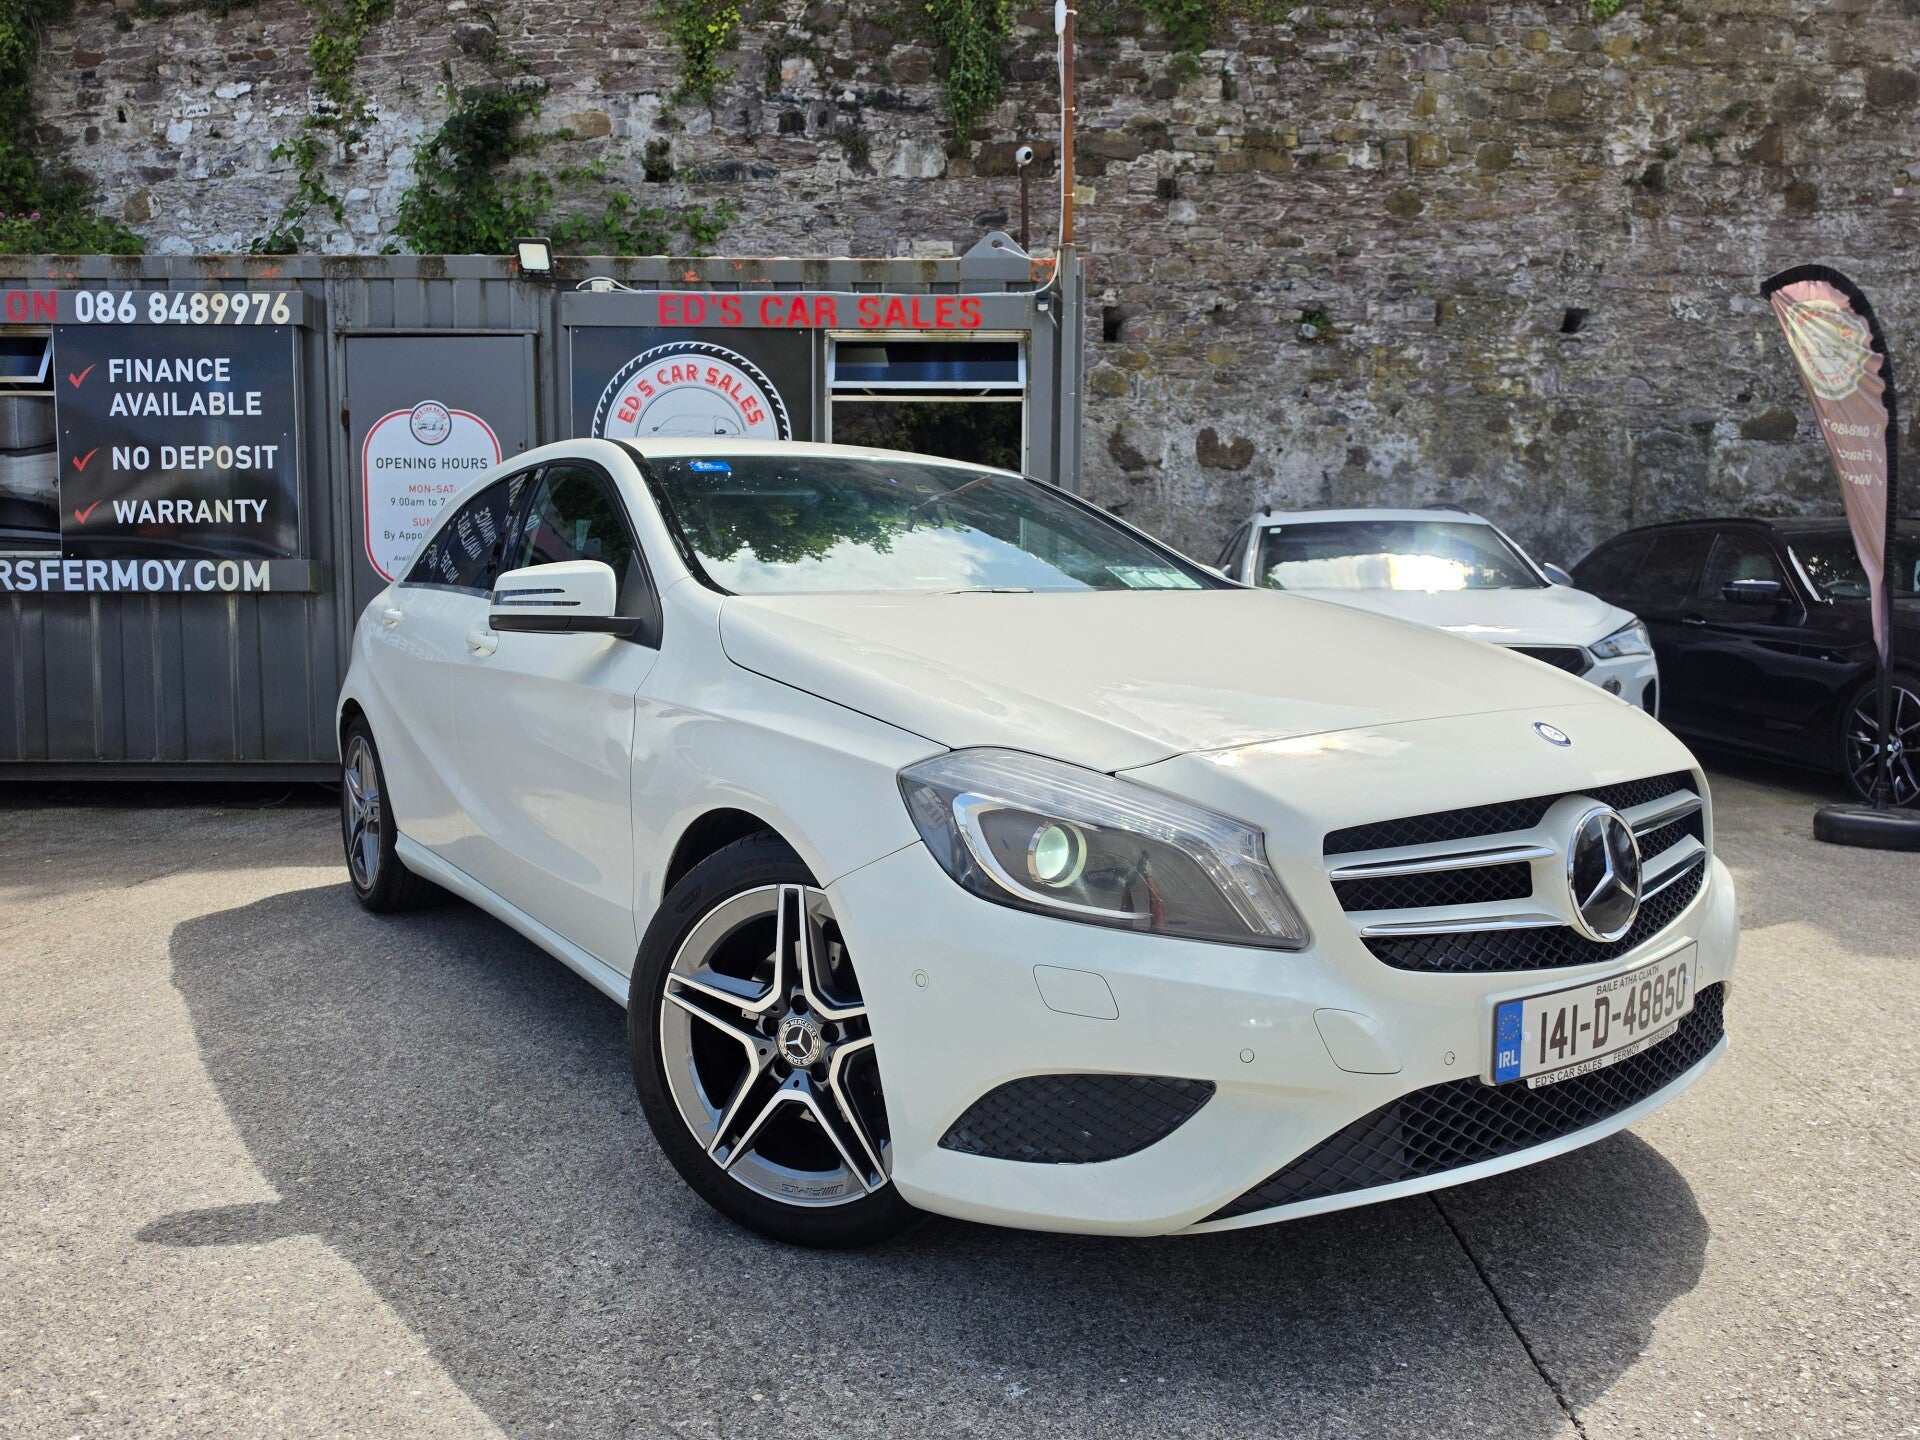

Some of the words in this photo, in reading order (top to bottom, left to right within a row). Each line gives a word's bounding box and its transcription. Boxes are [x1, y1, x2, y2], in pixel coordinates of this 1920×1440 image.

[6, 290, 58, 323] ON
[75, 291, 137, 323] 086
[148, 291, 291, 325] 8489976
[657, 293, 743, 326] ED'S
[759, 295, 838, 328] CAR
[857, 296, 982, 329] SALES
[108, 357, 231, 383] FINANCE
[109, 391, 262, 417] AVAILABLE
[617, 378, 657, 424] ED'S
[656, 363, 699, 386] CAR
[705, 366, 765, 426] SALES
[112, 446, 150, 471] NO
[161, 445, 279, 470] DEPOSIT
[376, 457, 437, 470] OPENING
[442, 457, 488, 470] HOURS
[112, 498, 267, 524] WARRANTY
[391, 497, 425, 507] 9.00am
[428, 497, 438, 507] to
[384, 531, 395, 542] By
[399, 530, 426, 542] Appo
[1597, 979, 1618, 996] BAILE
[1638, 965, 1659, 981] CLIATH
[1540, 962, 1687, 1064] 141-D-48850
[1498, 1049, 1519, 1068] IRL
[1535, 1074, 1555, 1088] ED'S
[1557, 1067, 1575, 1081] CAR
[1577, 1059, 1603, 1075] SALES
[1613, 1043, 1641, 1063] FERMOY
